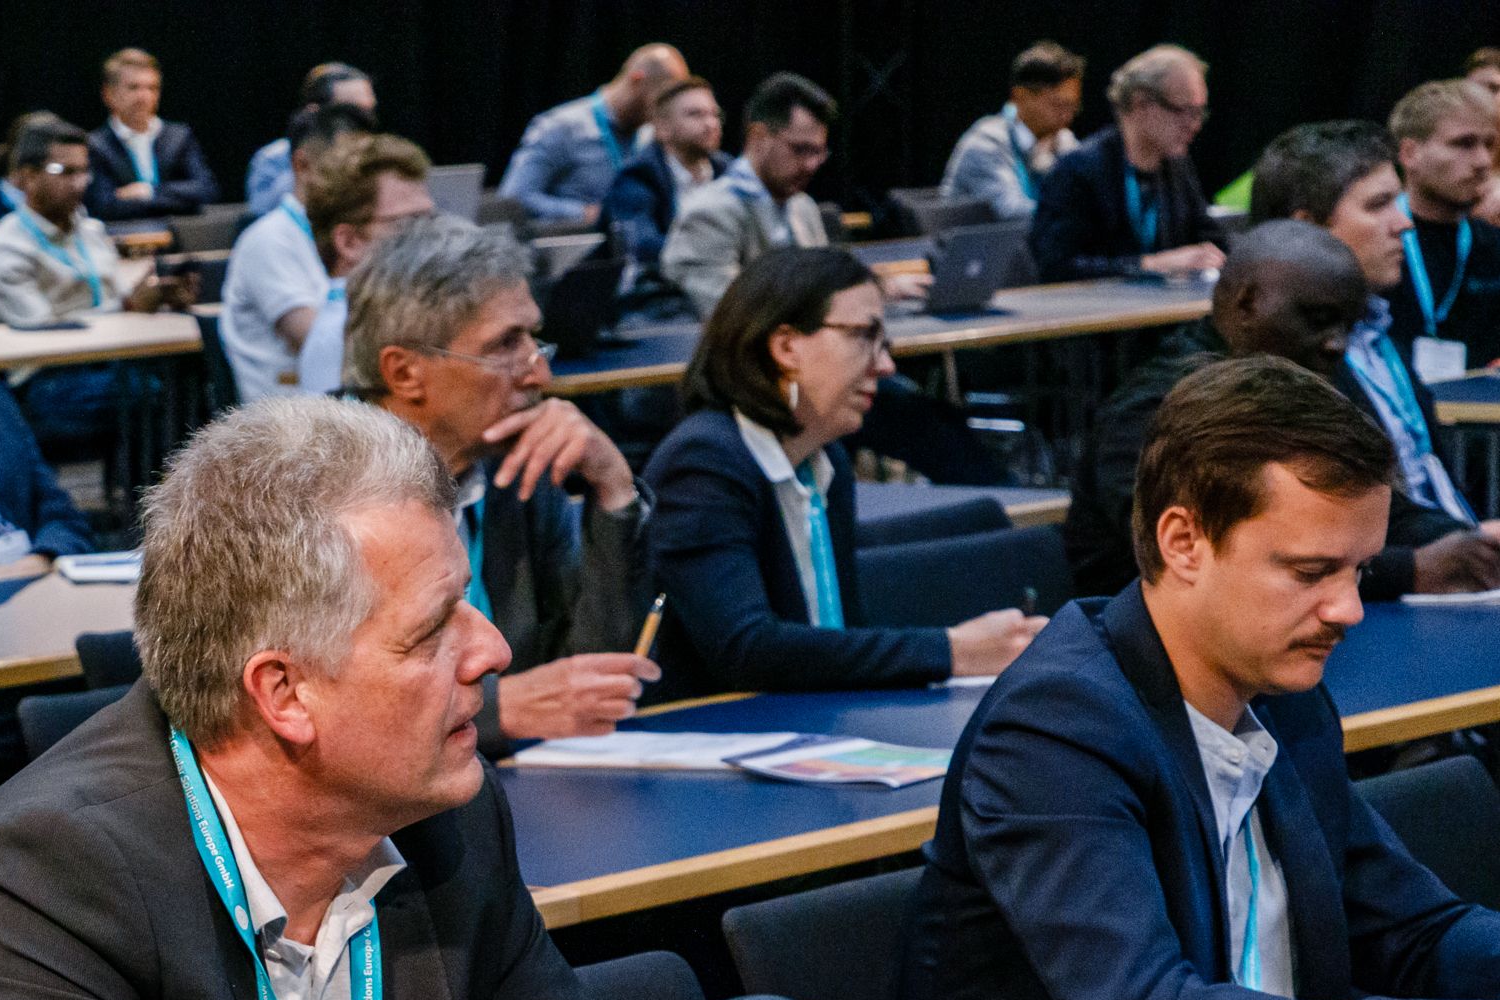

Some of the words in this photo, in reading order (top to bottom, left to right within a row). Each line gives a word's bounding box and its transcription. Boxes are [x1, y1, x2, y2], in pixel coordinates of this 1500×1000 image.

[180, 774, 203, 820] Solutions
[198, 819, 219, 856] Europe
[214, 855, 235, 889] GmbH
[363, 939, 374, 976] Europe
